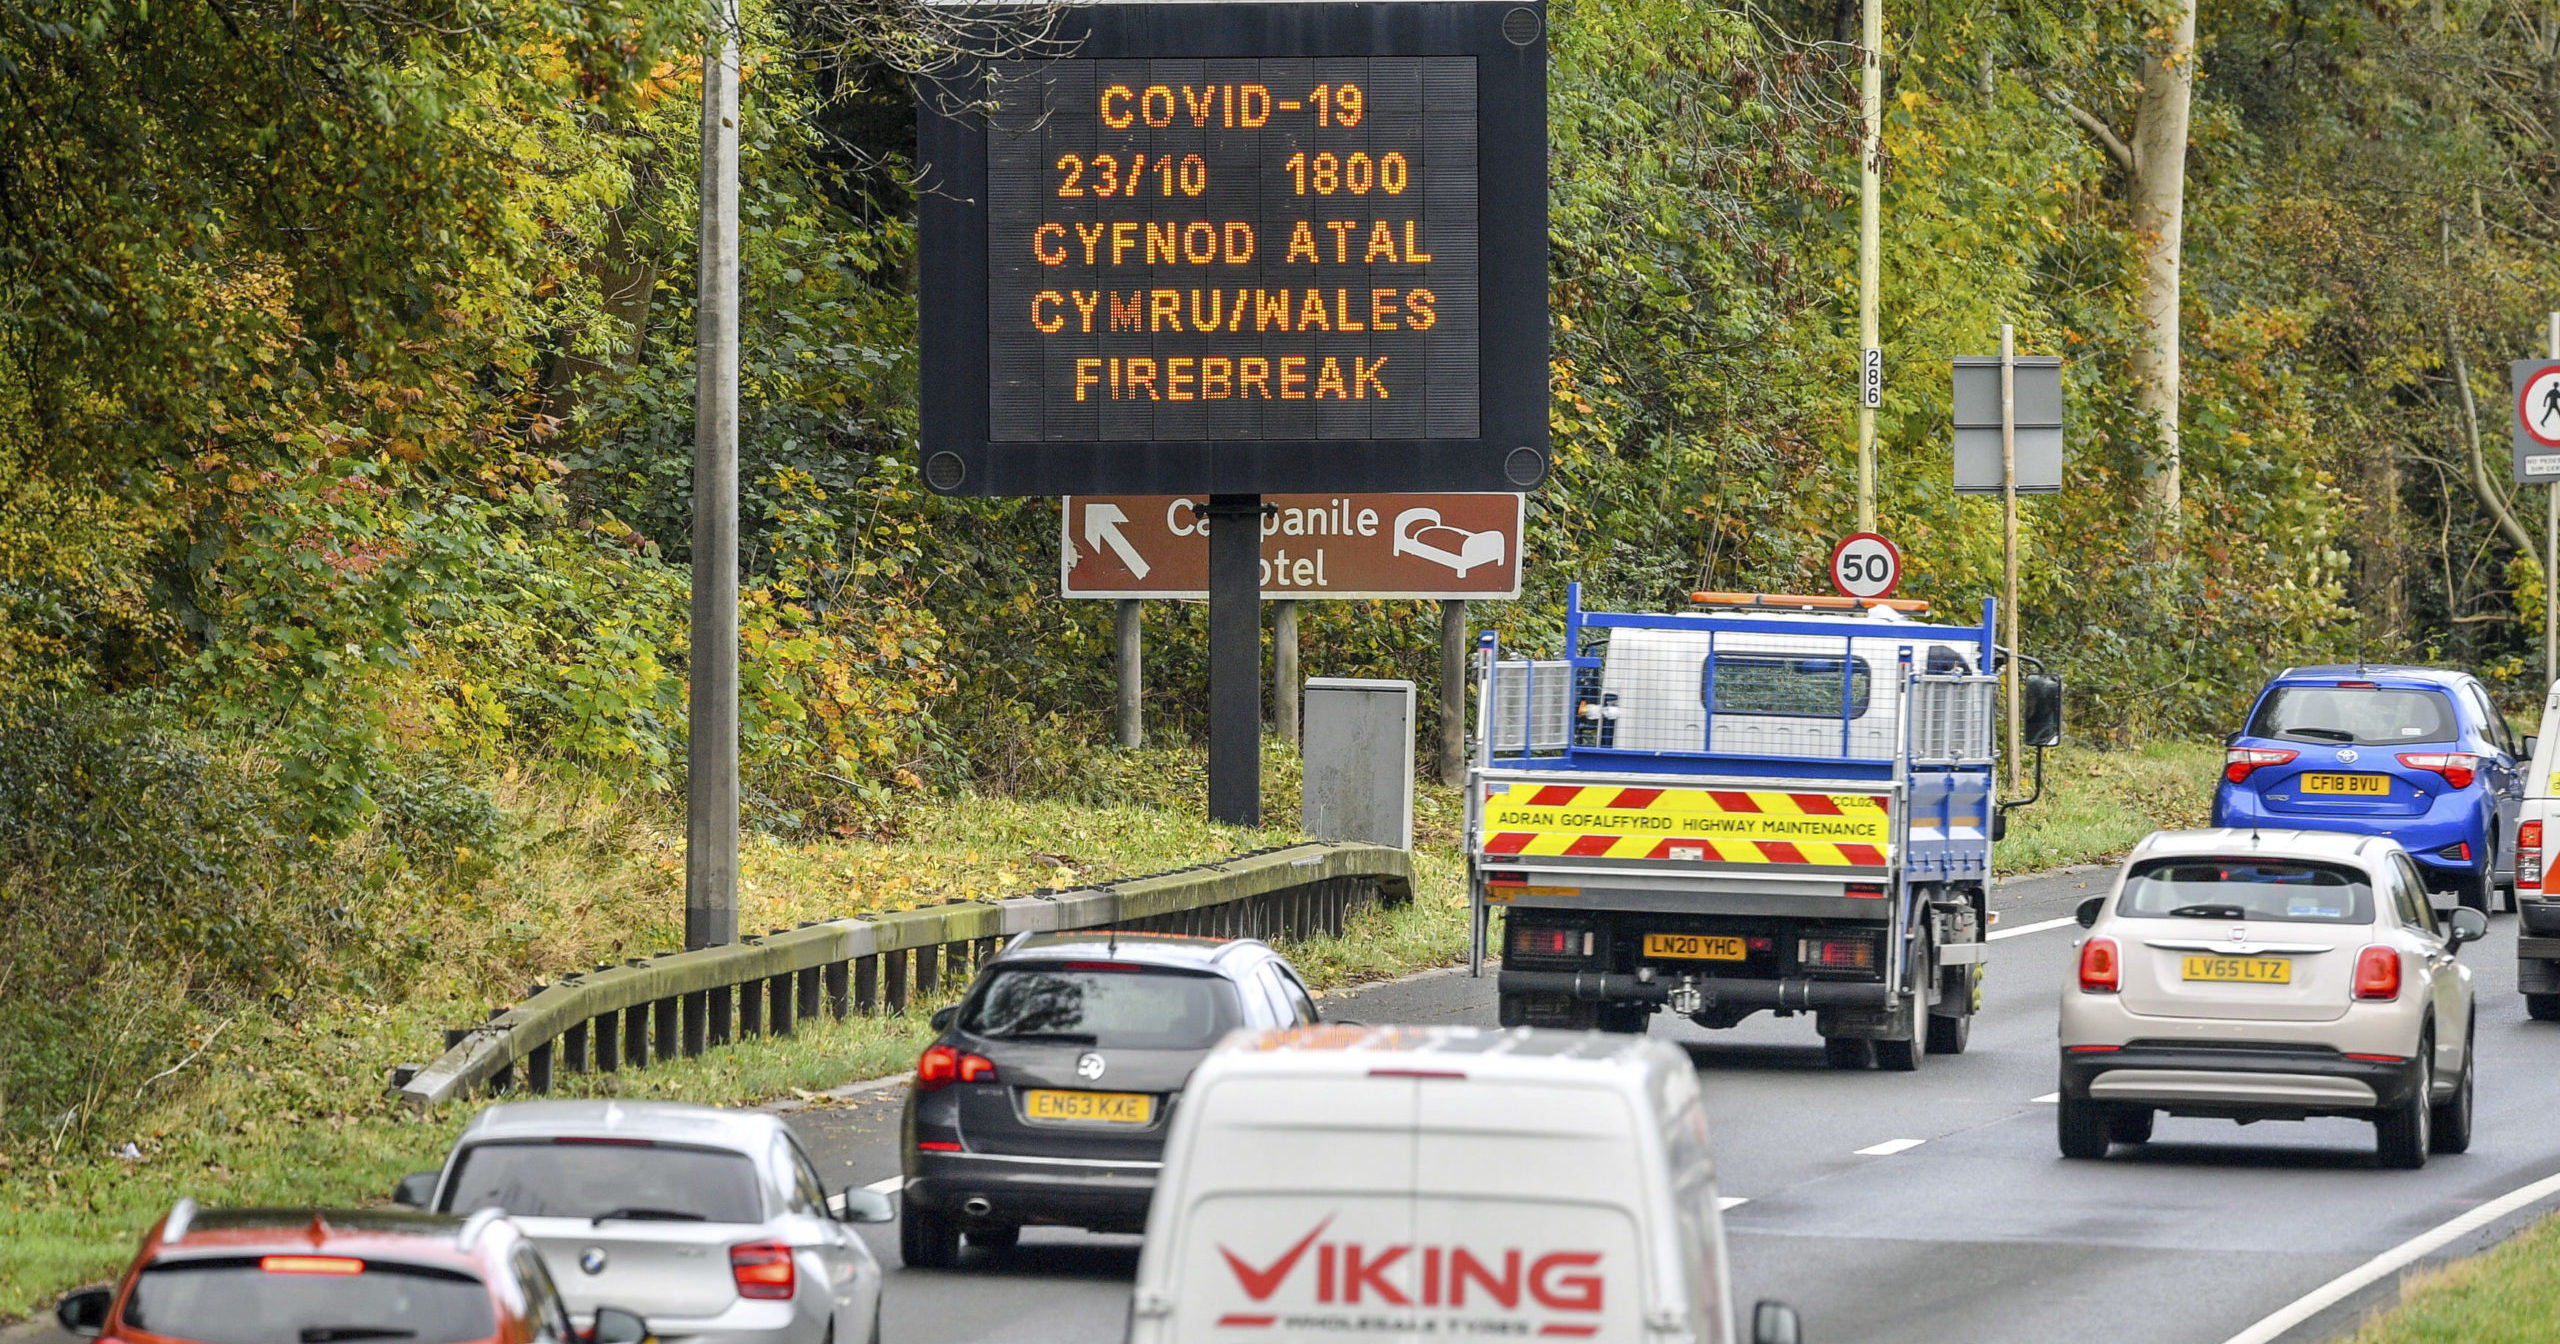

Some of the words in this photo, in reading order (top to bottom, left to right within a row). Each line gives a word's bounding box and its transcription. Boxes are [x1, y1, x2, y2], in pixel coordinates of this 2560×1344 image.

[1100, 83, 1363, 129] COVID-19
[1057, 153, 1206, 198] 23/10
[1285, 151, 1408, 196] 1800
[1033, 221, 1255, 266] CYFNOD
[1286, 219, 1432, 264] ATAL
[1031, 288, 1437, 333] CYMRU/WALES
[1075, 355, 1389, 402] FIREBREAK
[1868, 350, 1879, 404] 286
[1843, 554, 1889, 582] 50
[2311, 776, 2344, 791] CF18
[2349, 777, 2379, 791] BVU
[1498, 812, 1554, 826] ADRAN
[1560, 814, 1673, 830] GOFALFFYRDD
[1682, 818, 1756, 832] HIGHWAY
[1762, 821, 1876, 837] MAINTENANCE
[1651, 936, 1697, 954] LN20
[1704, 938, 1737, 956] YHC
[2189, 959, 2239, 977] LV65
[2244, 961, 2282, 979] LTZ
[1038, 1094, 1092, 1115] EN63
[1099, 1098, 1140, 1117] KXE
[1216, 1211, 1604, 1312] VIKING
